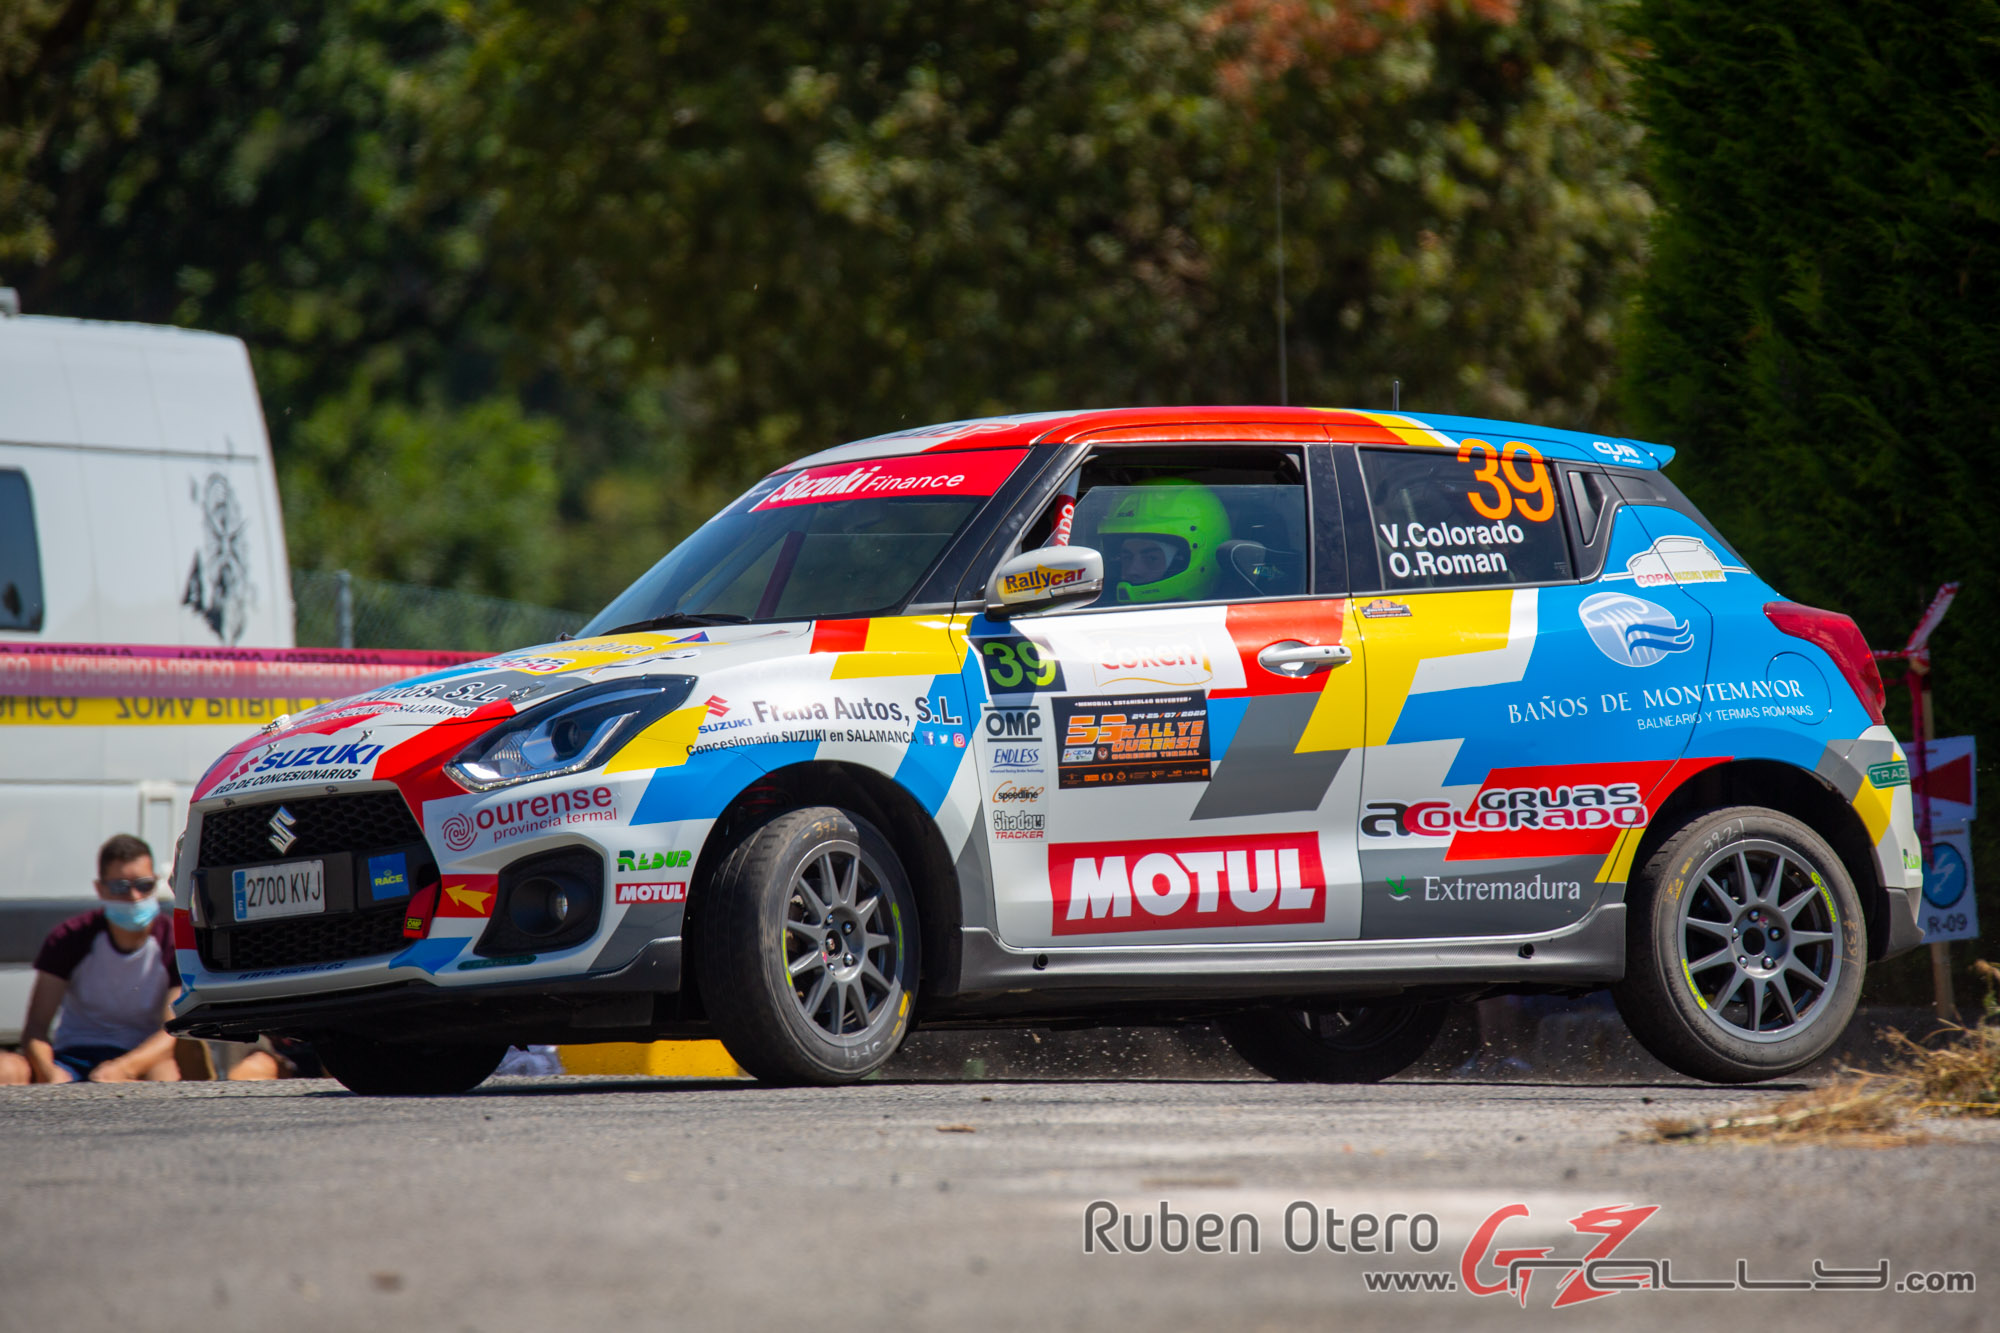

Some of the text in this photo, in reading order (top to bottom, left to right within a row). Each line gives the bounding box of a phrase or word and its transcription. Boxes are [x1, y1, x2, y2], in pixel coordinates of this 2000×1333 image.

[770, 466, 882, 502] Suzuki
[862, 474, 965, 492] Finance
[1458, 438, 1555, 522] 39
[1380, 520, 1524, 548] V.Colorado
[1389, 552, 1508, 578] O.Roman
[1005, 567, 1086, 592] Rallycar
[1637, 573, 1672, 585] COPA
[983, 641, 1057, 688] 39
[834, 696, 910, 726] Autos,
[914, 696, 962, 725] S.L.
[1508, 680, 1804, 724] BAÑOS DE MONTEMAYOR
[698, 718, 753, 735] SUZUKI
[986, 712, 1041, 736] OMP
[1122, 720, 1204, 739] RALLYE
[1637, 705, 1814, 730] BALNEARIO Y TERMAS ROMANAS
[686, 729, 918, 757] Concesionario SUZUKI en SALAMANCA
[994, 748, 1039, 763] ENDLESS
[1111, 736, 1201, 752] OURENSE
[254, 745, 385, 773] SUZUKI
[211, 769, 361, 796] RED DE CONCESIONARIOS
[476, 786, 612, 830] ourense
[993, 810, 1045, 830] Shadow
[494, 807, 617, 843] provincia termal
[995, 831, 1044, 840] TRACKER
[246, 871, 321, 908] 2700 KVJ
[374, 873, 404, 886] RACE
[1066, 849, 1316, 921] MOTUL
[1424, 875, 1580, 901] Extremadura
[618, 884, 684, 902] MOTUL
[1927, 913, 1968, 935] R-09
